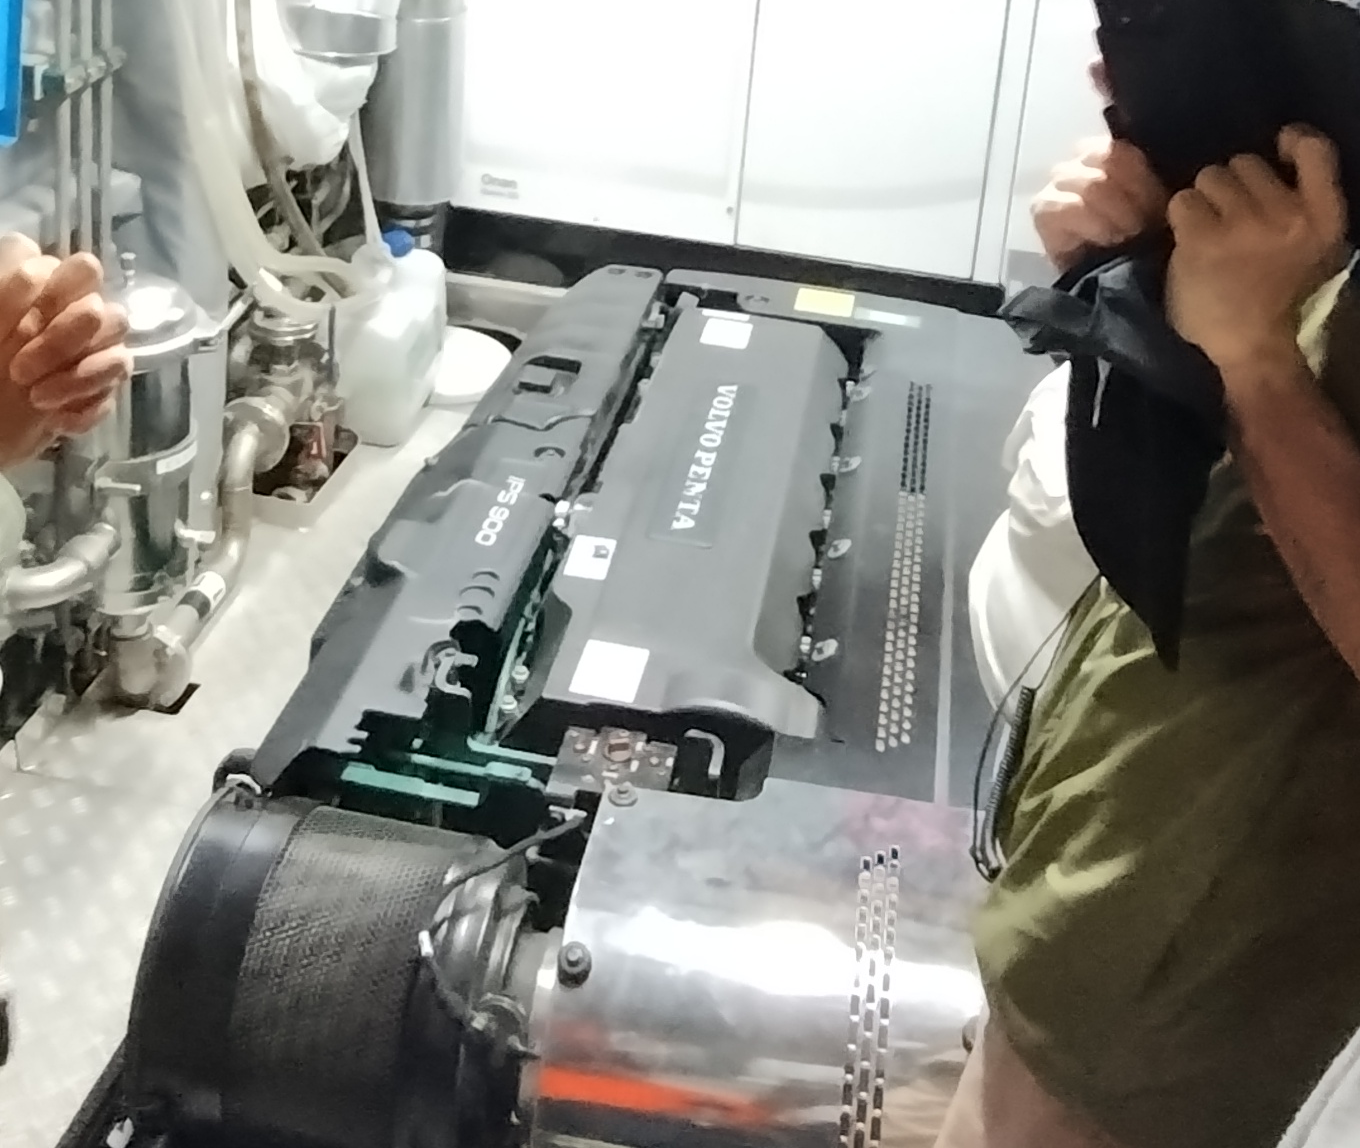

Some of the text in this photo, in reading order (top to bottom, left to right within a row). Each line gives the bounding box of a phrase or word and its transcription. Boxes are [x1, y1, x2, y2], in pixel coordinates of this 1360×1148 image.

[474, 475, 526, 546] IPS 900
[670, 384, 739, 531] VOLVO PENTA
